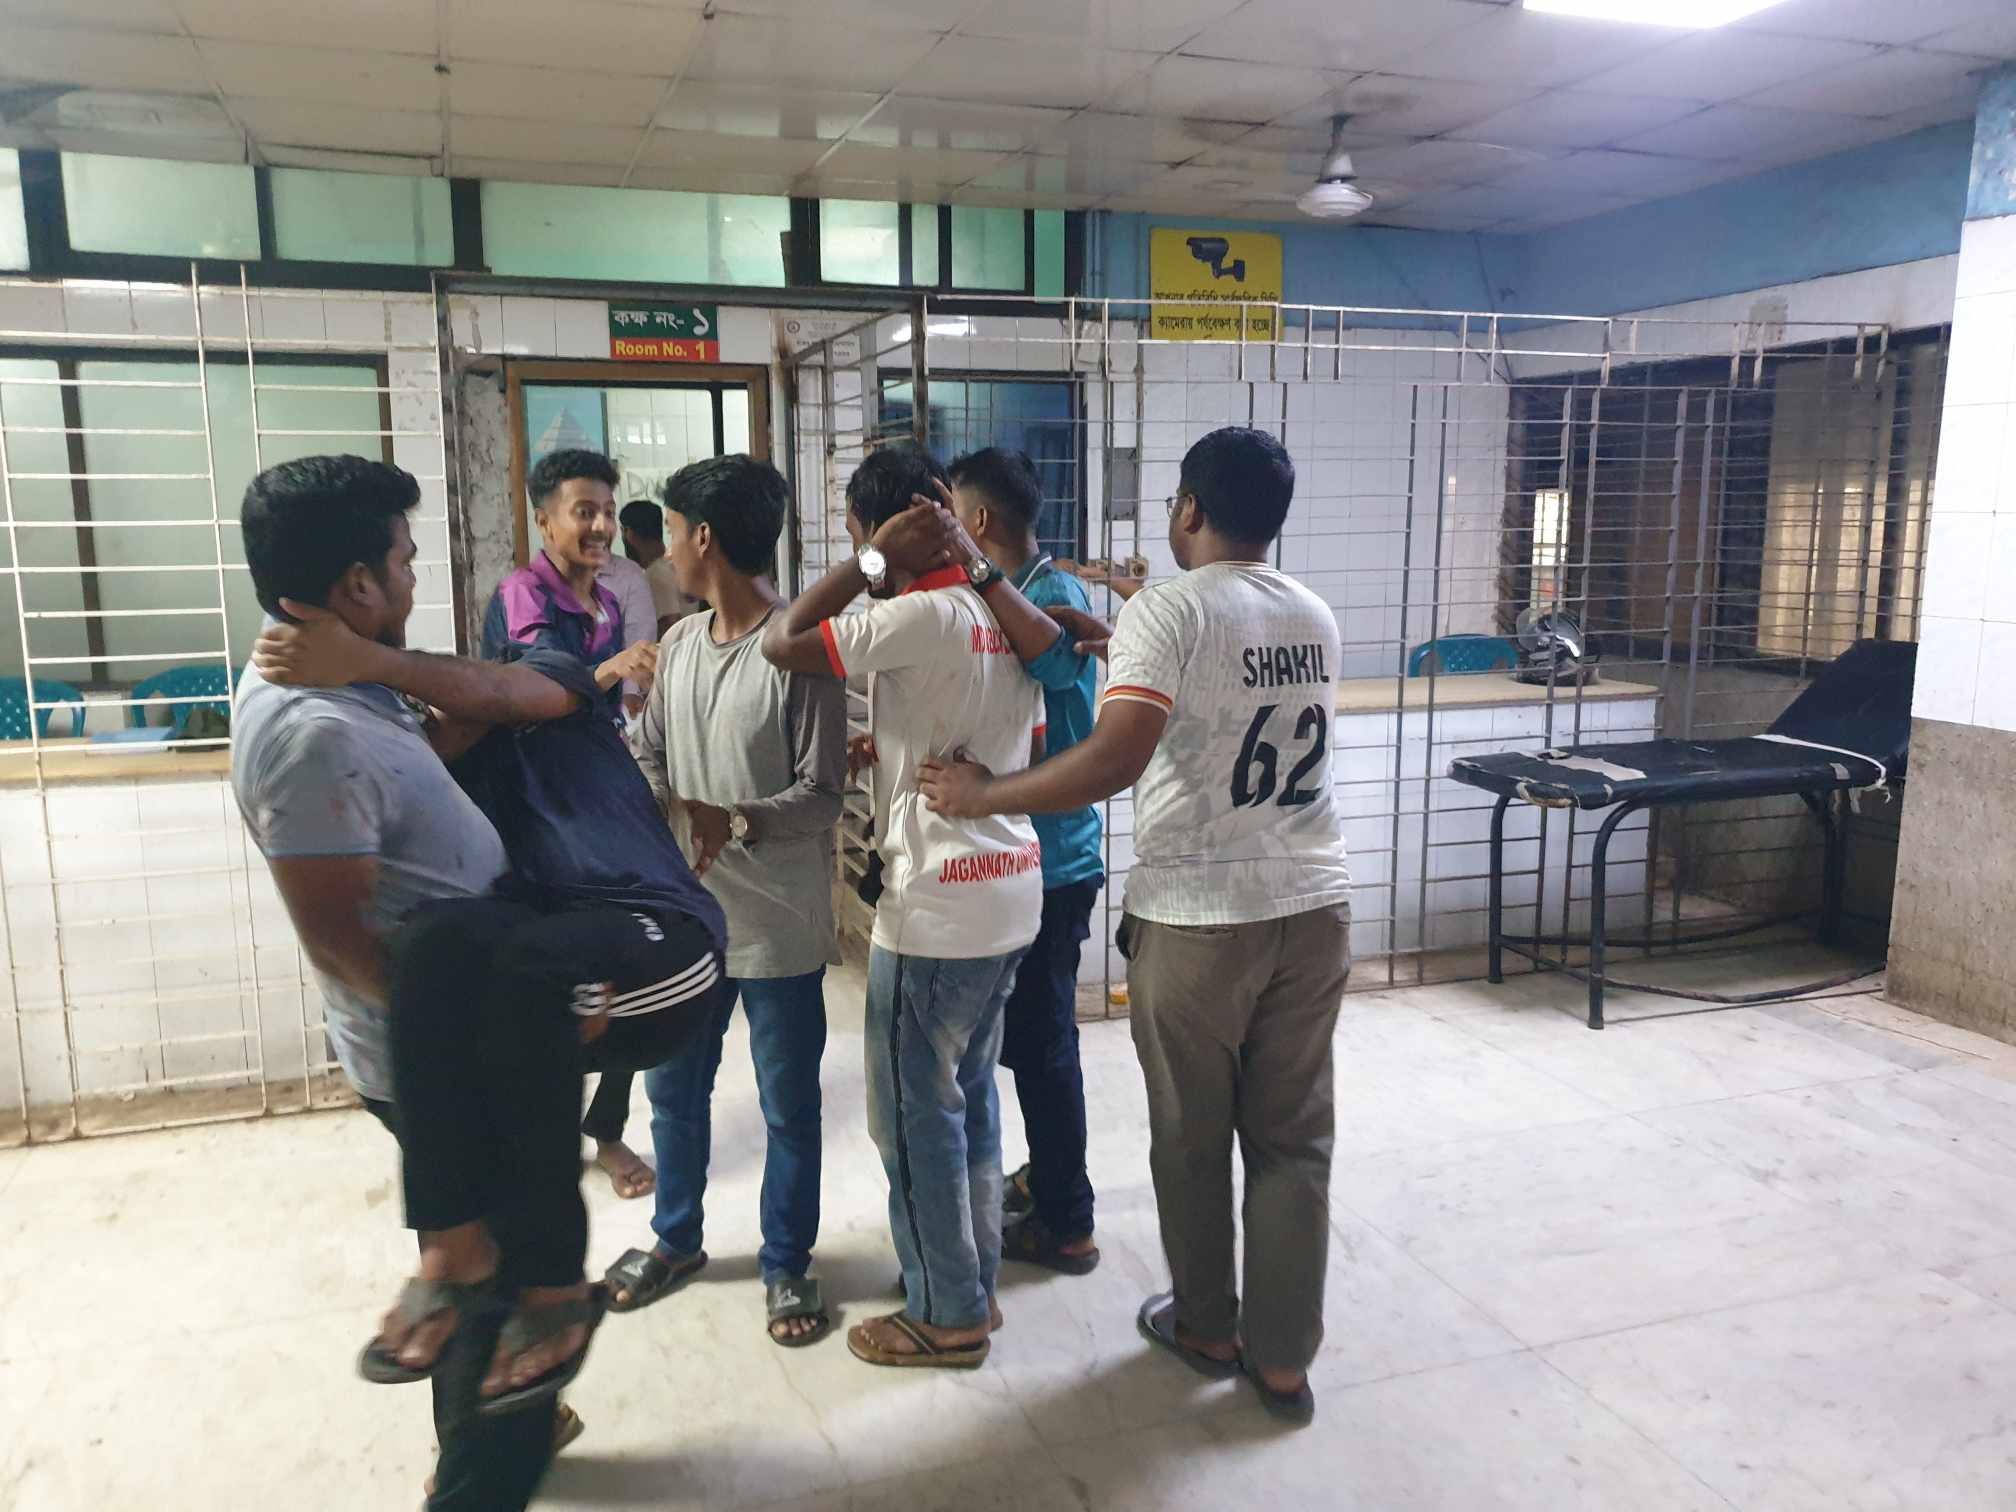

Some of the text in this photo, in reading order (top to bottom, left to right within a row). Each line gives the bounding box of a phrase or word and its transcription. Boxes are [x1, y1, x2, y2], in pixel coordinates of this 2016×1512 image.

[611, 310, 650, 328] কক্ষ
[693, 308, 709, 336] ১
[615, 341, 705, 360] Room No. 1
[1242, 644, 1330, 688] SHAKIL
[1230, 703, 1327, 808] 62
[939, 851, 1015, 884] JAGANNATH
